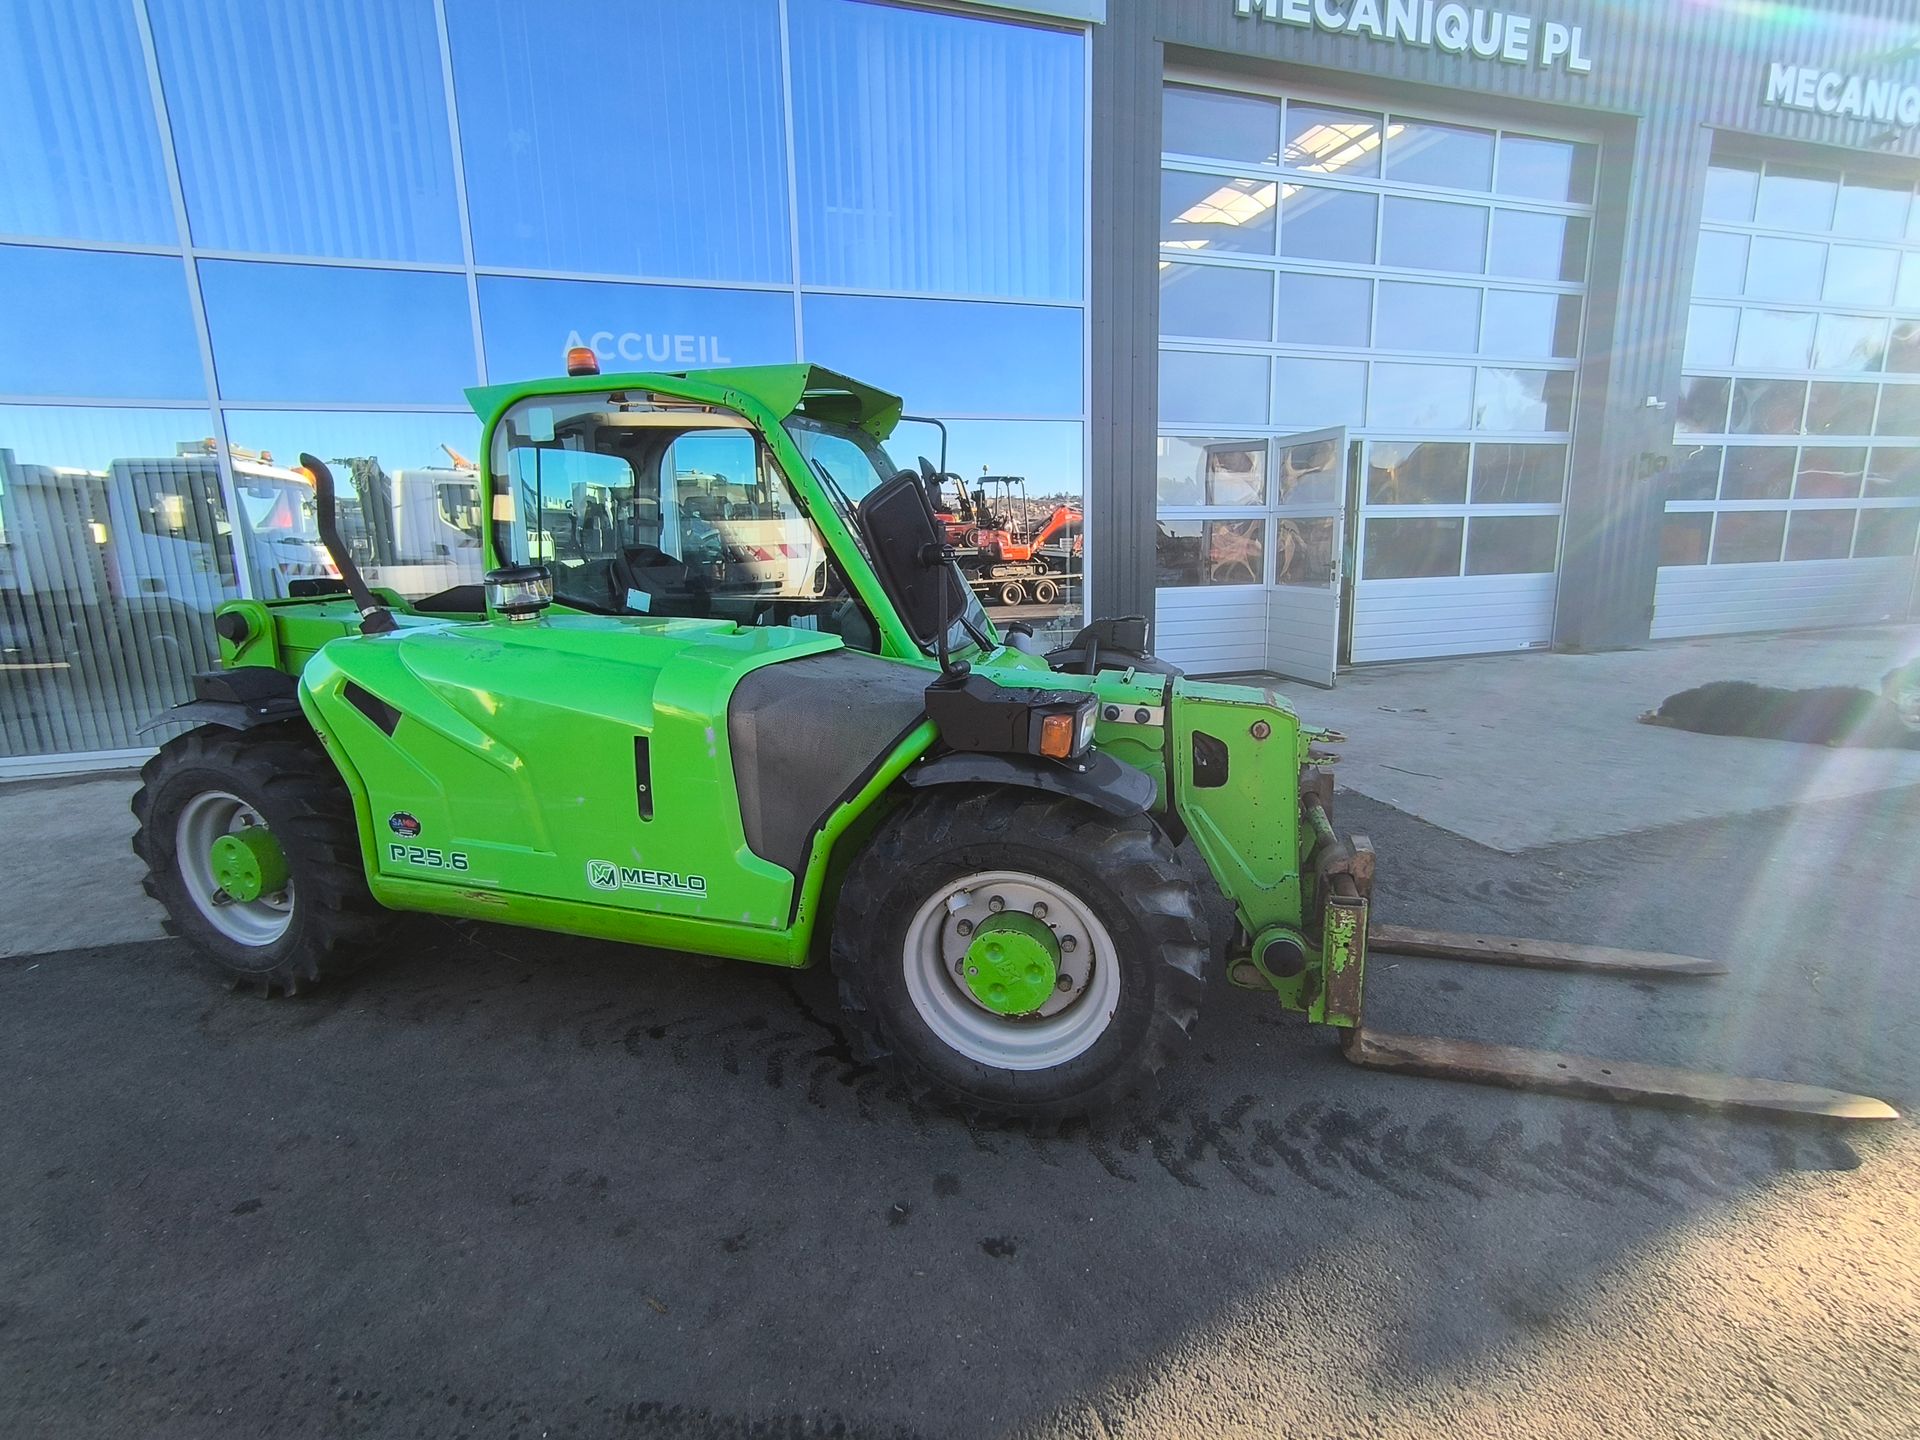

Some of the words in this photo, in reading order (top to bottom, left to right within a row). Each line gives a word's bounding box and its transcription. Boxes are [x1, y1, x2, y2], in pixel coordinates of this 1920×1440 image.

[1542, 22, 1592, 72] PL
[562, 329, 732, 364] ACCUEIL
[389, 843, 469, 871] P25.6
[620, 867, 706, 891] MERLO
